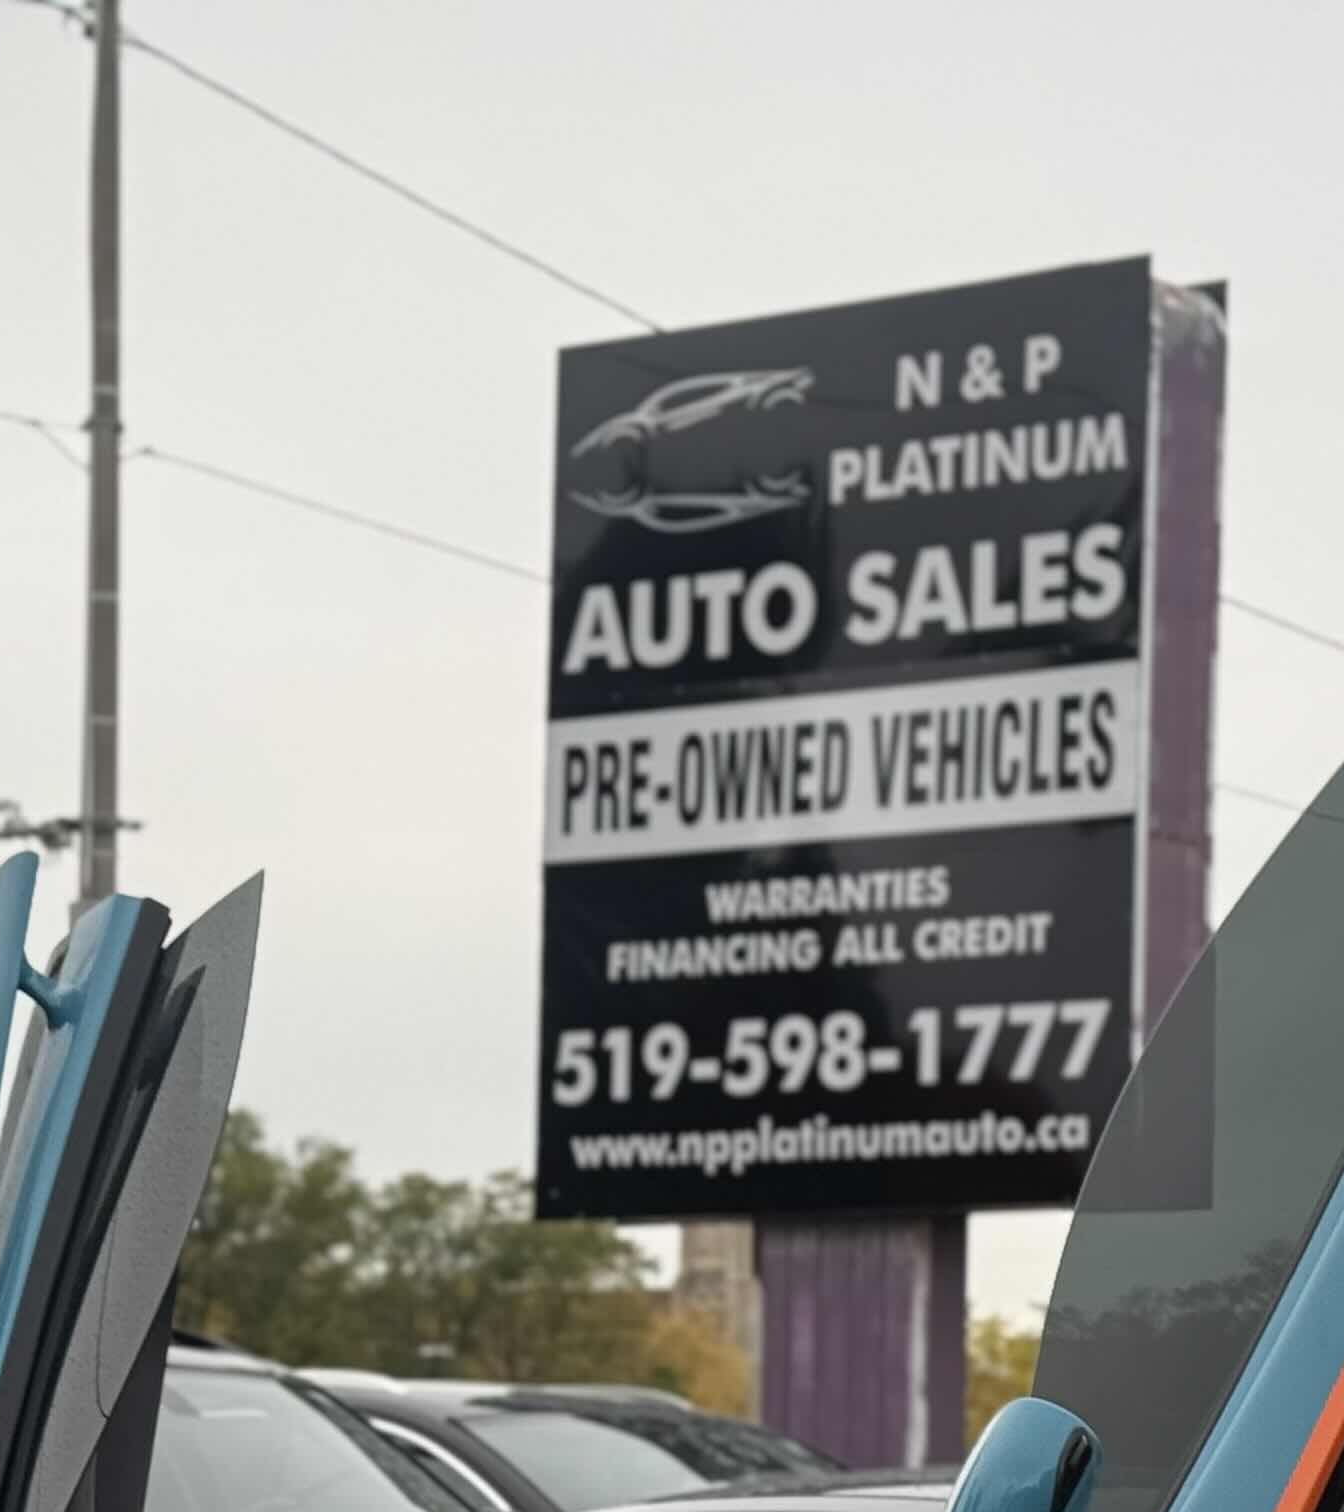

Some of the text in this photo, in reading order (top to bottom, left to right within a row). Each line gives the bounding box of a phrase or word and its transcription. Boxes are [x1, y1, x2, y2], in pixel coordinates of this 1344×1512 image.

[894, 334, 1061, 411] N & P
[828, 412, 1128, 506] PLATINUM
[562, 523, 1127, 674] AUTO SALES
[562, 690, 1116, 835] PRE-OWNED VEHICLES
[705, 866, 950, 924] WARRANTIES
[607, 912, 1053, 983] FINANCING ALL CREDIT
[552, 999, 1112, 1106] 519-598-1777
[569, 1111, 1090, 1177] www.npplatinumauto.ca
